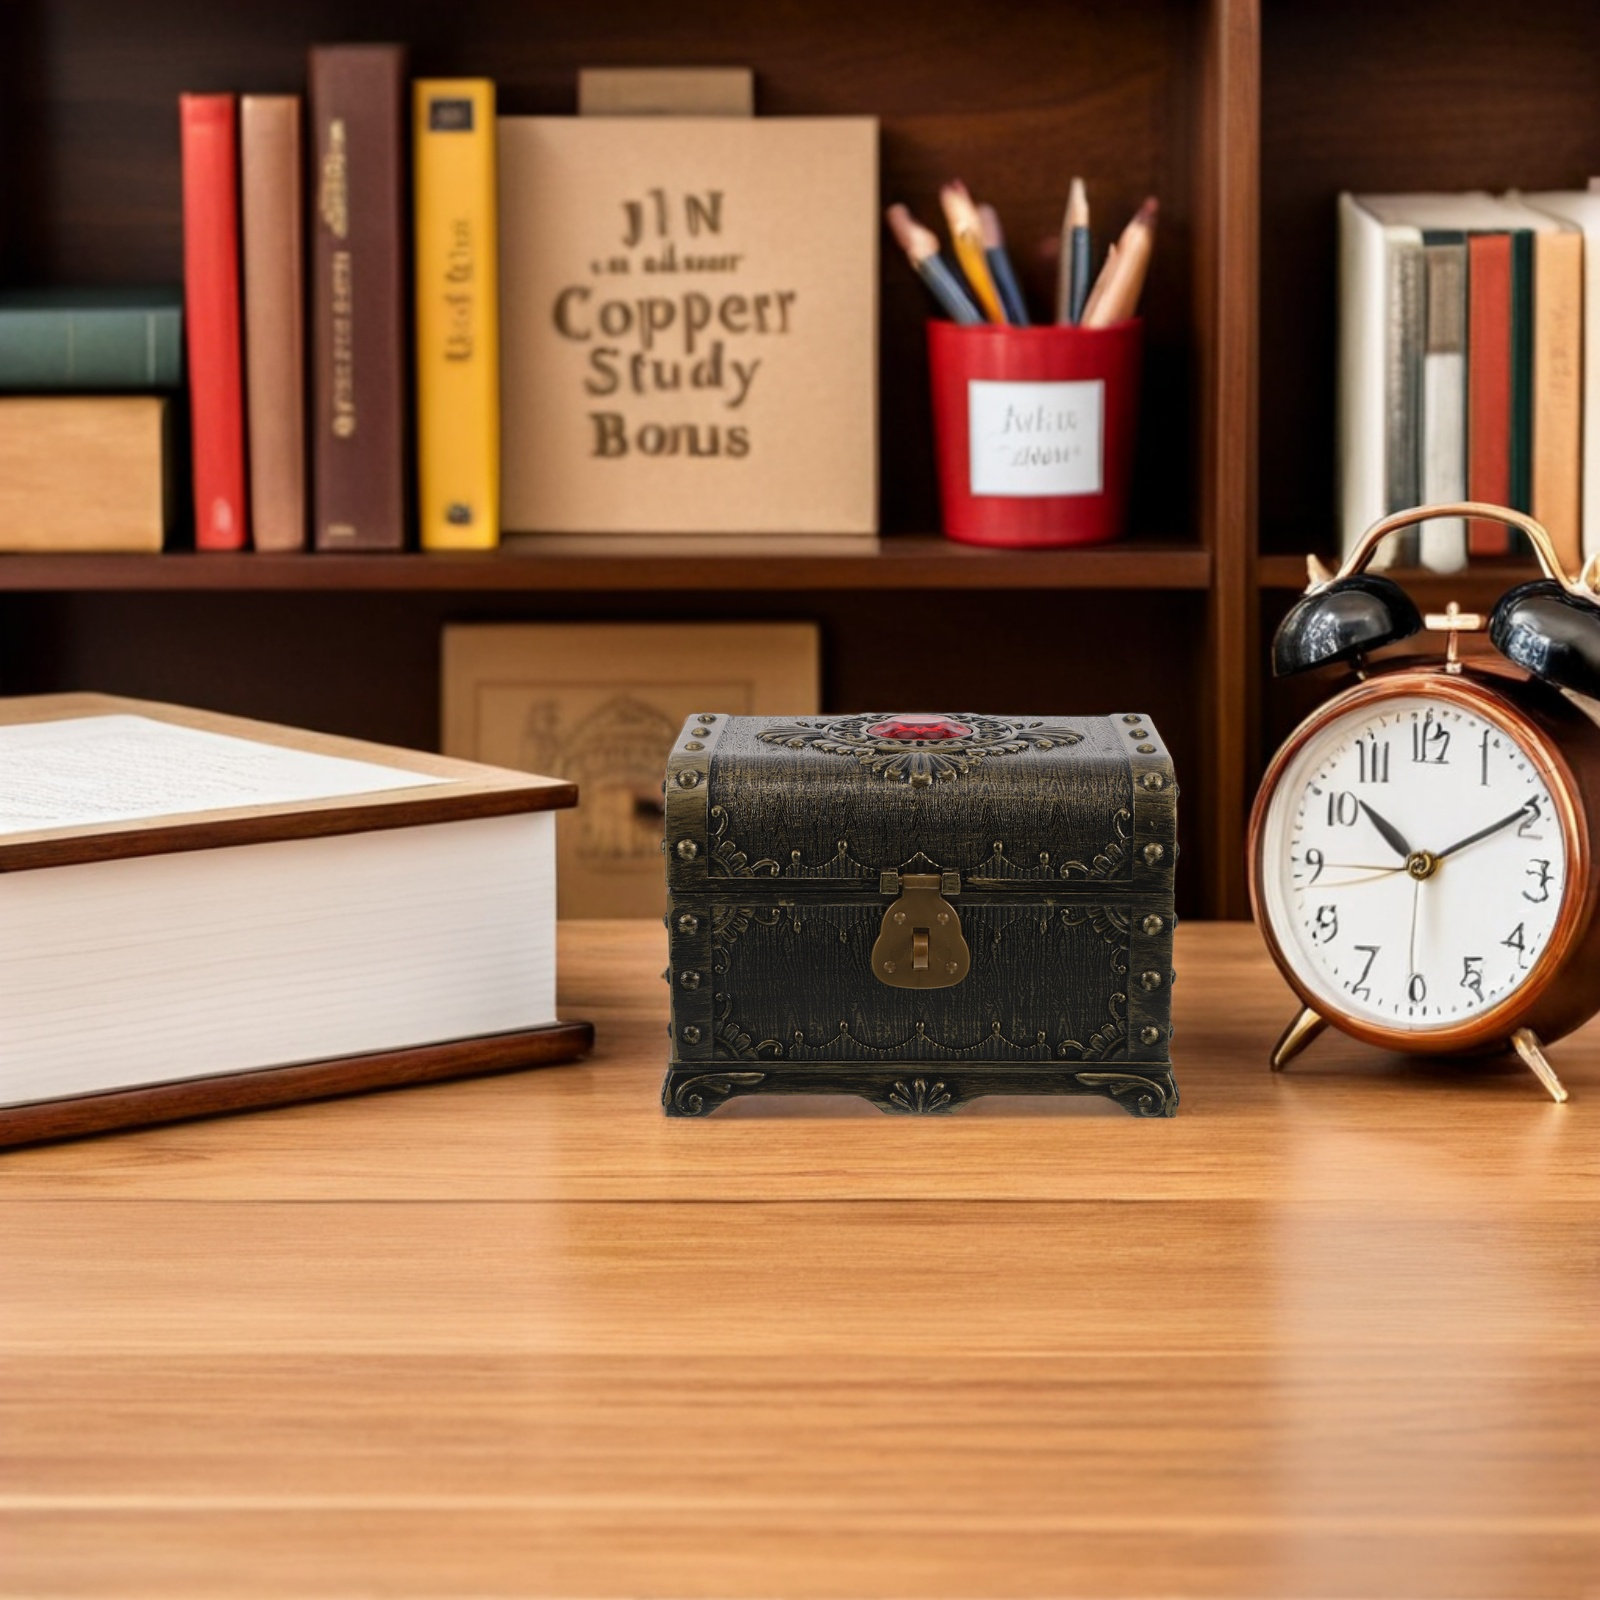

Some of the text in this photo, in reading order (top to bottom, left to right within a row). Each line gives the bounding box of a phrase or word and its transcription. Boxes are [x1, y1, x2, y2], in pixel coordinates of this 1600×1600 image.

[583, 340, 763, 410] Study
[587, 411, 752, 459] Bonus
[1327, 791, 1359, 827] 10
[1305, 848, 1324, 884] 9
